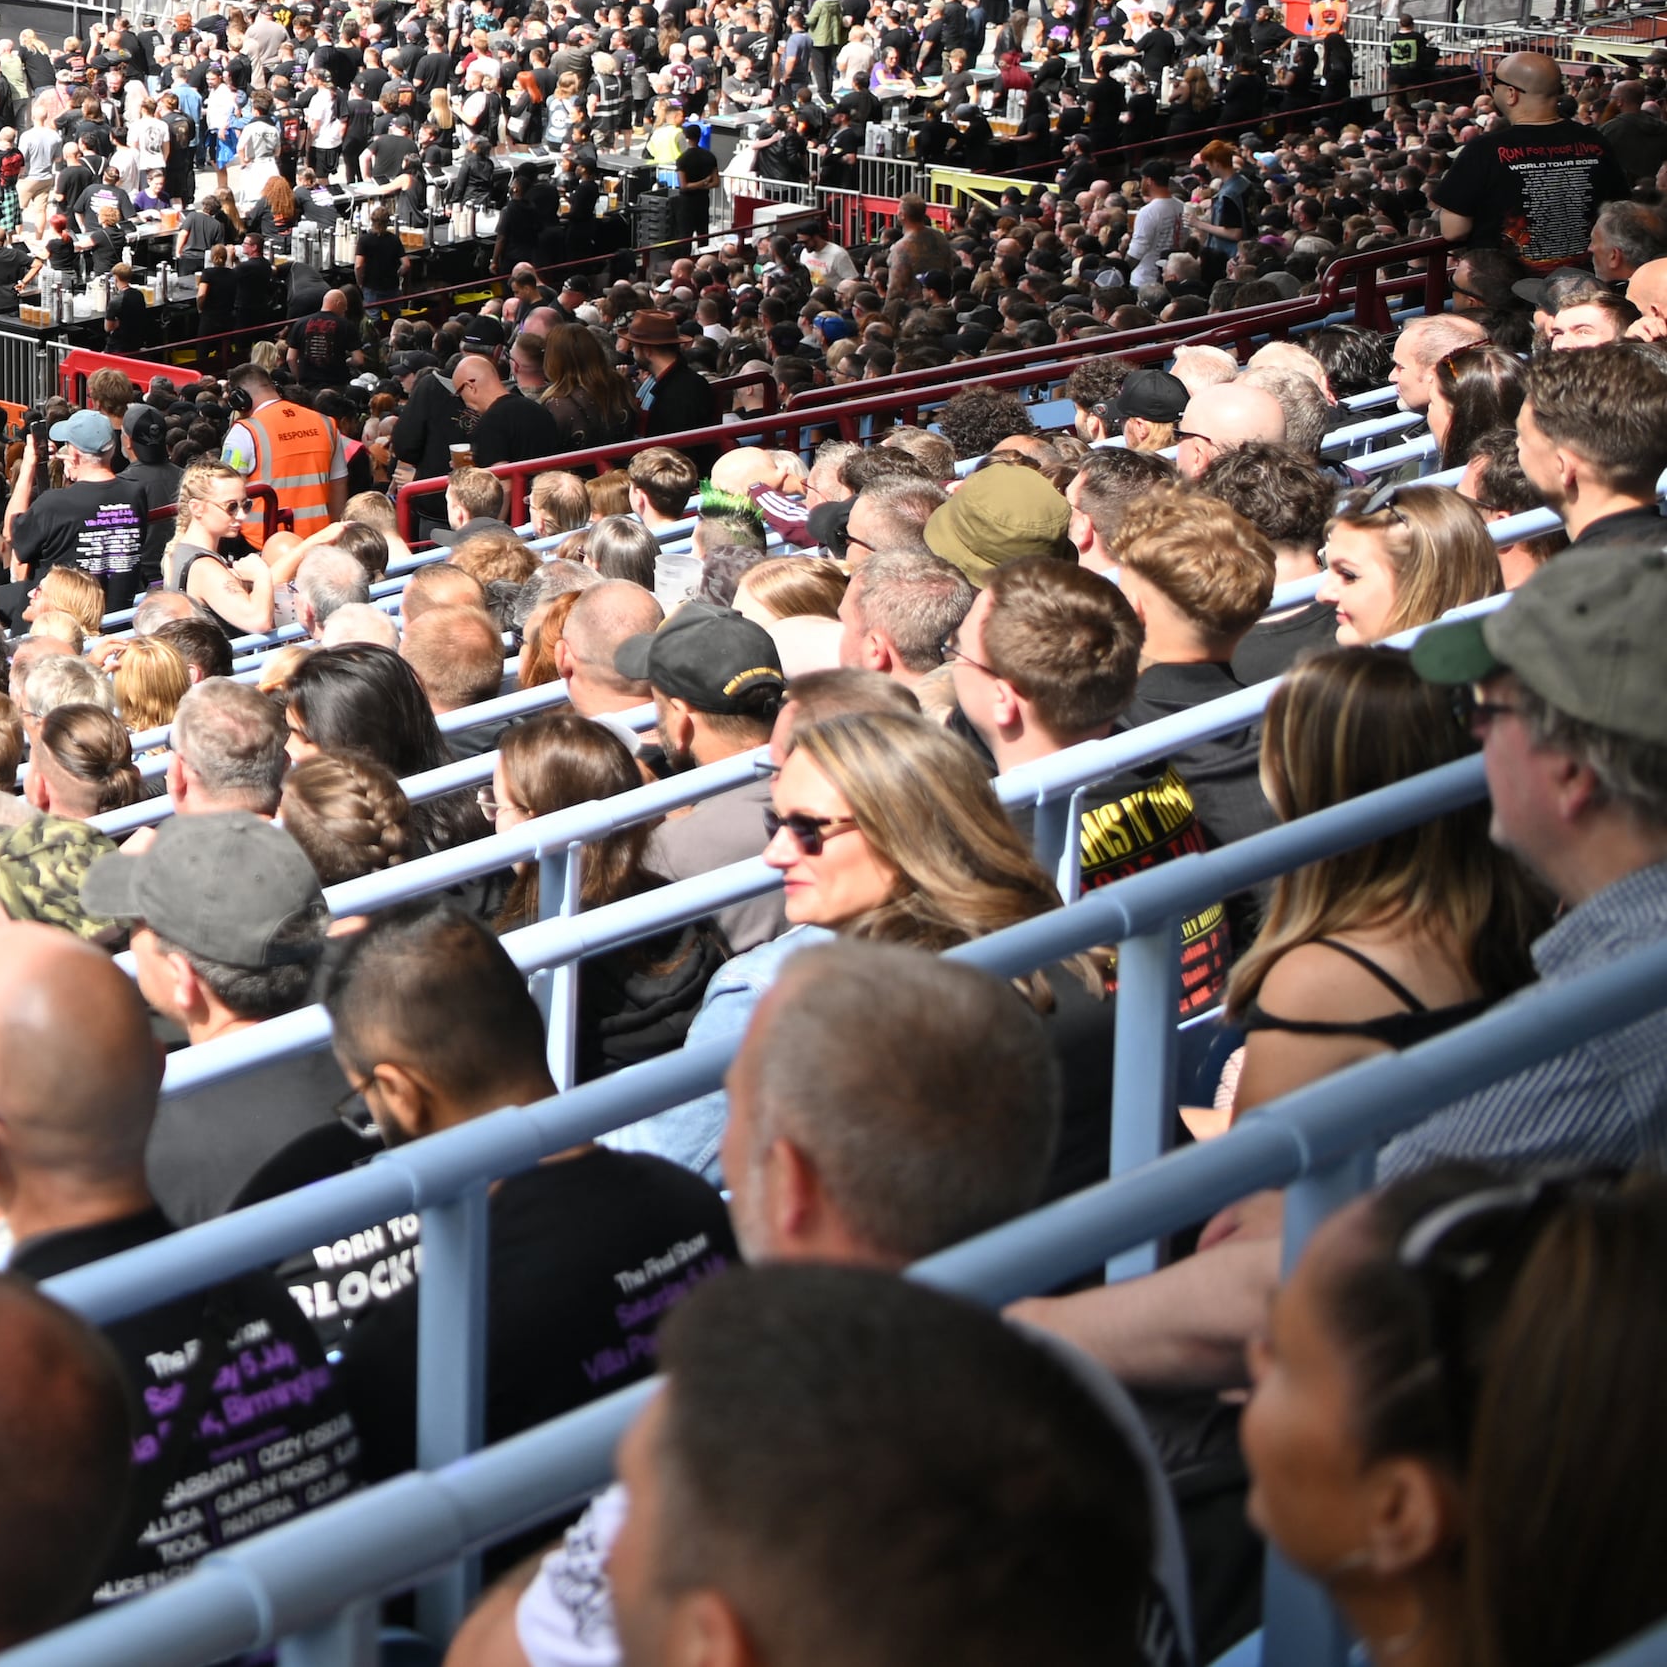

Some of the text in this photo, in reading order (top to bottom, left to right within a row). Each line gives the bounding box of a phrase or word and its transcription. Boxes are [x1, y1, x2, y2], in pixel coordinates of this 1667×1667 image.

[1497, 145, 1525, 163] RUN
[1508, 158, 1599, 171] WORLD TOUR 2025
[282, 408, 295, 418] 95
[278, 428, 319, 442] RESPONSE
[387, 1212, 419, 1244] TO
[614, 1268, 644, 1292] The
[675, 1233, 708, 1266] Show
[145, 1343, 185, 1378] The
[156, 1533, 211, 1566] TOOL
